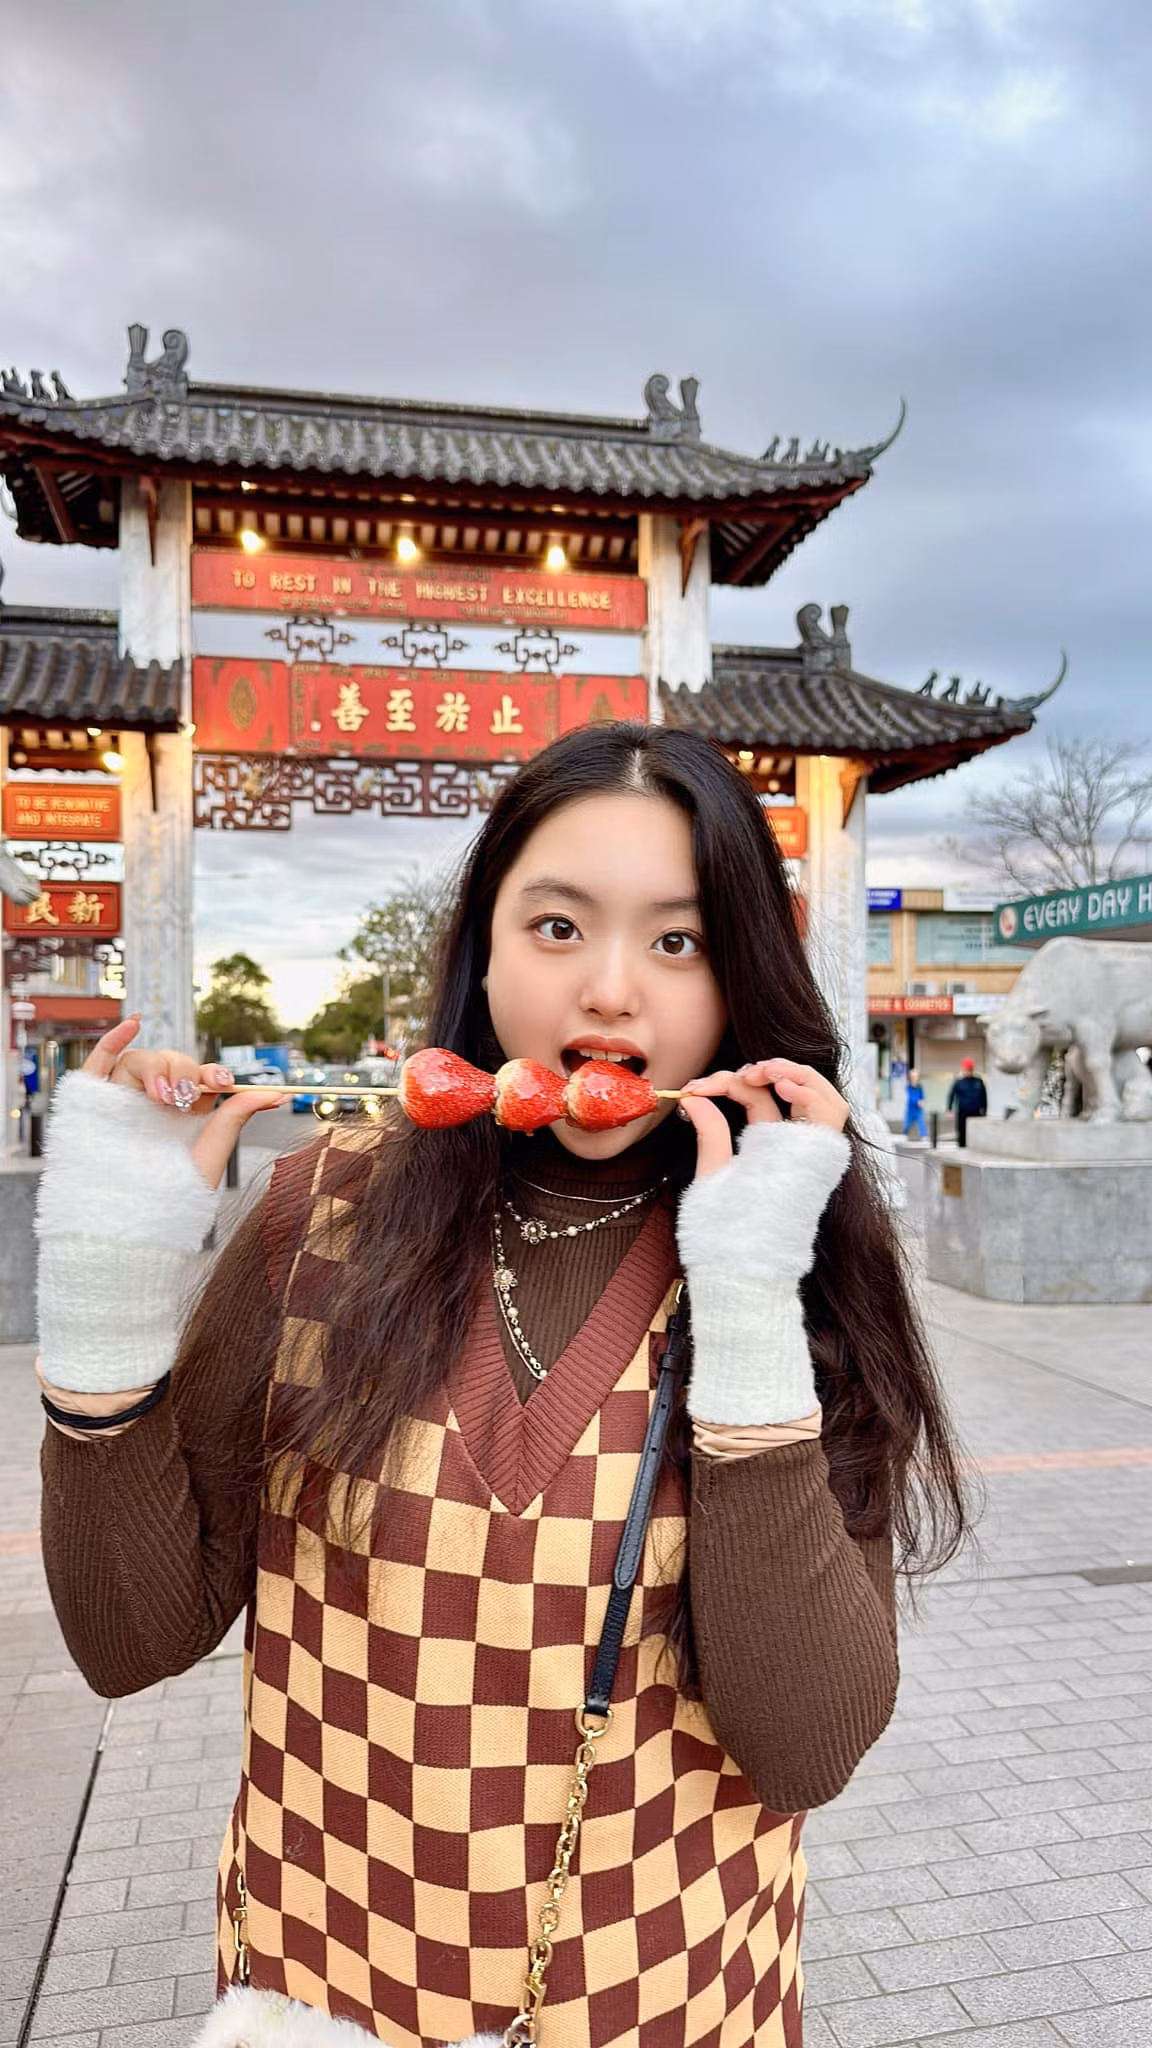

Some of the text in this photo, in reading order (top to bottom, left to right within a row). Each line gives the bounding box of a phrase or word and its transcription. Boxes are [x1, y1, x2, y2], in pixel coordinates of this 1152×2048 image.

[232, 569, 612, 610] TO REST IN THE HIGHEST EXCELLENCE
[1023, 895, 1083, 932] EVERY
[1087, 885, 1132, 922] DAY
